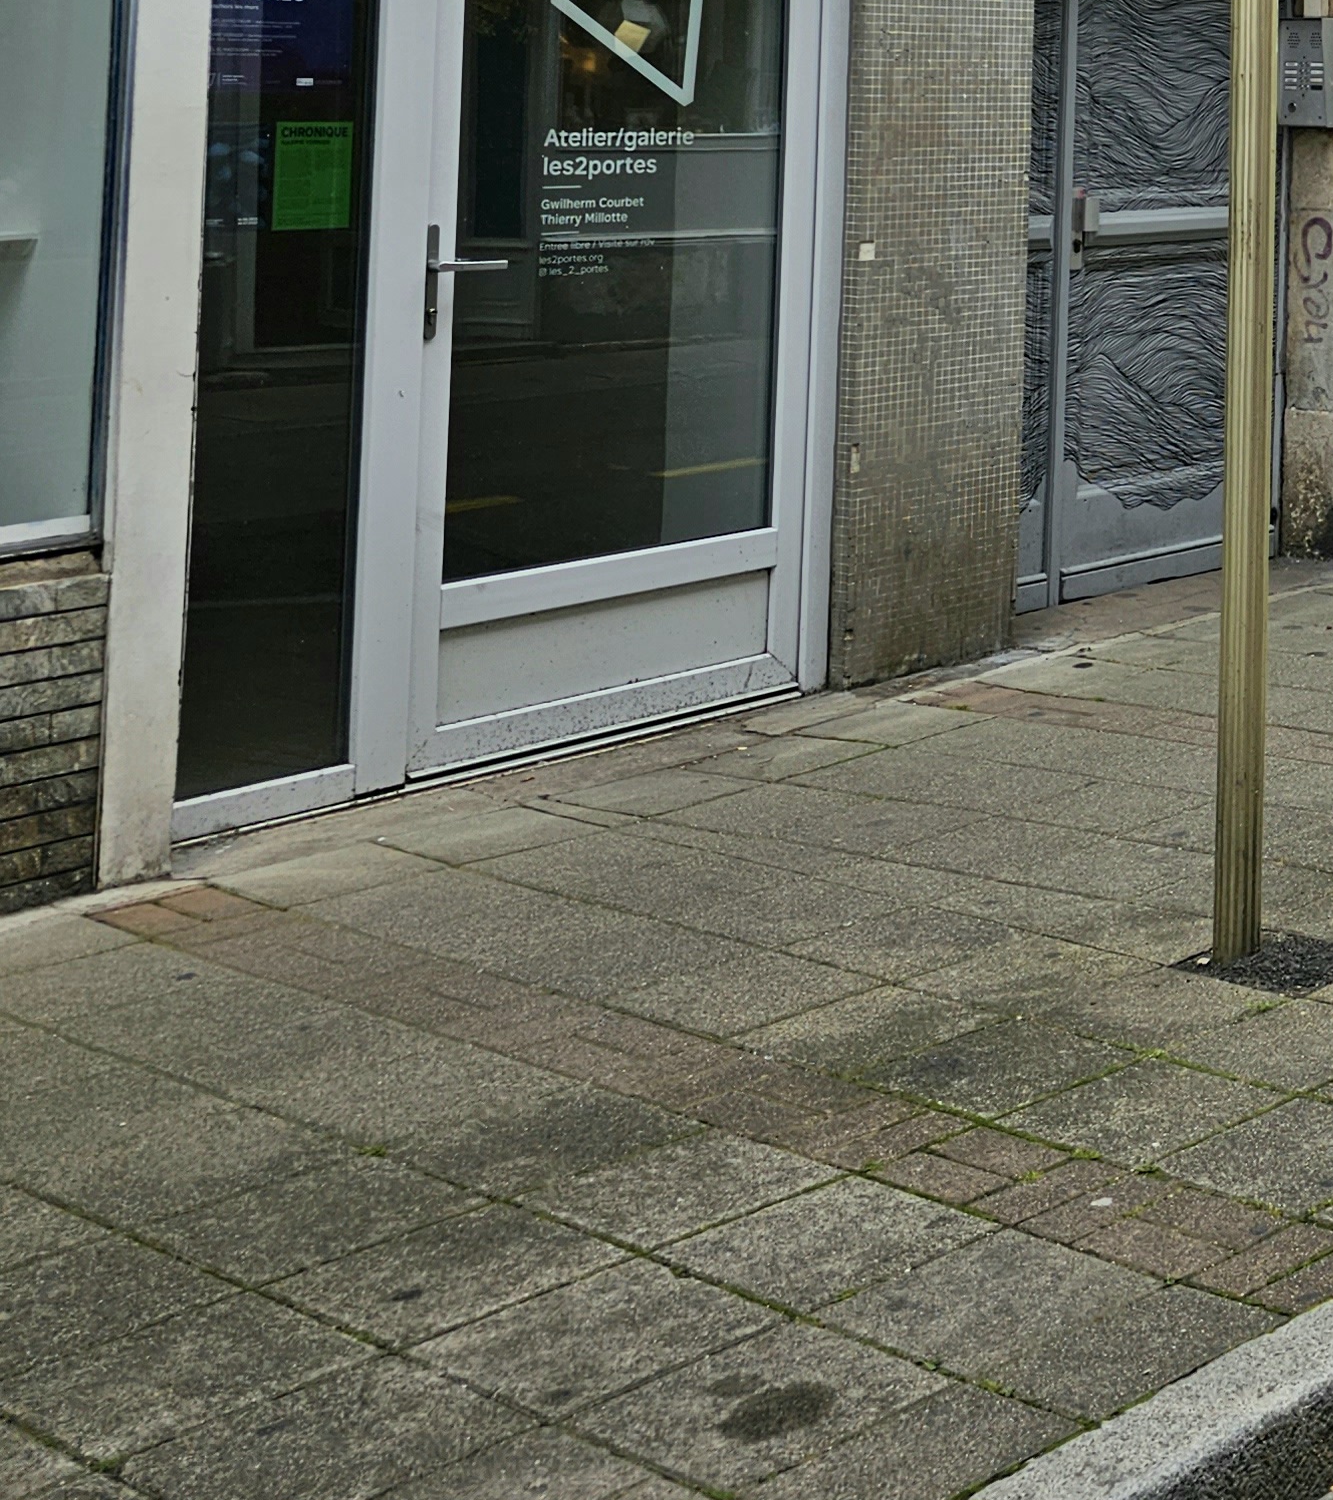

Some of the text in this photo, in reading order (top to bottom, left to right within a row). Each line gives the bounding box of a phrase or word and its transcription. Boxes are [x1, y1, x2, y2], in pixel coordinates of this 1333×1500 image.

[280, 127, 349, 138] CHRONIQUE
[543, 126, 694, 151] Atelier/galerie
[542, 156, 658, 180] les2portes
[541, 197, 644, 210] Gwilherm Courbet
[541, 212, 628, 227] Thierry Millotte
